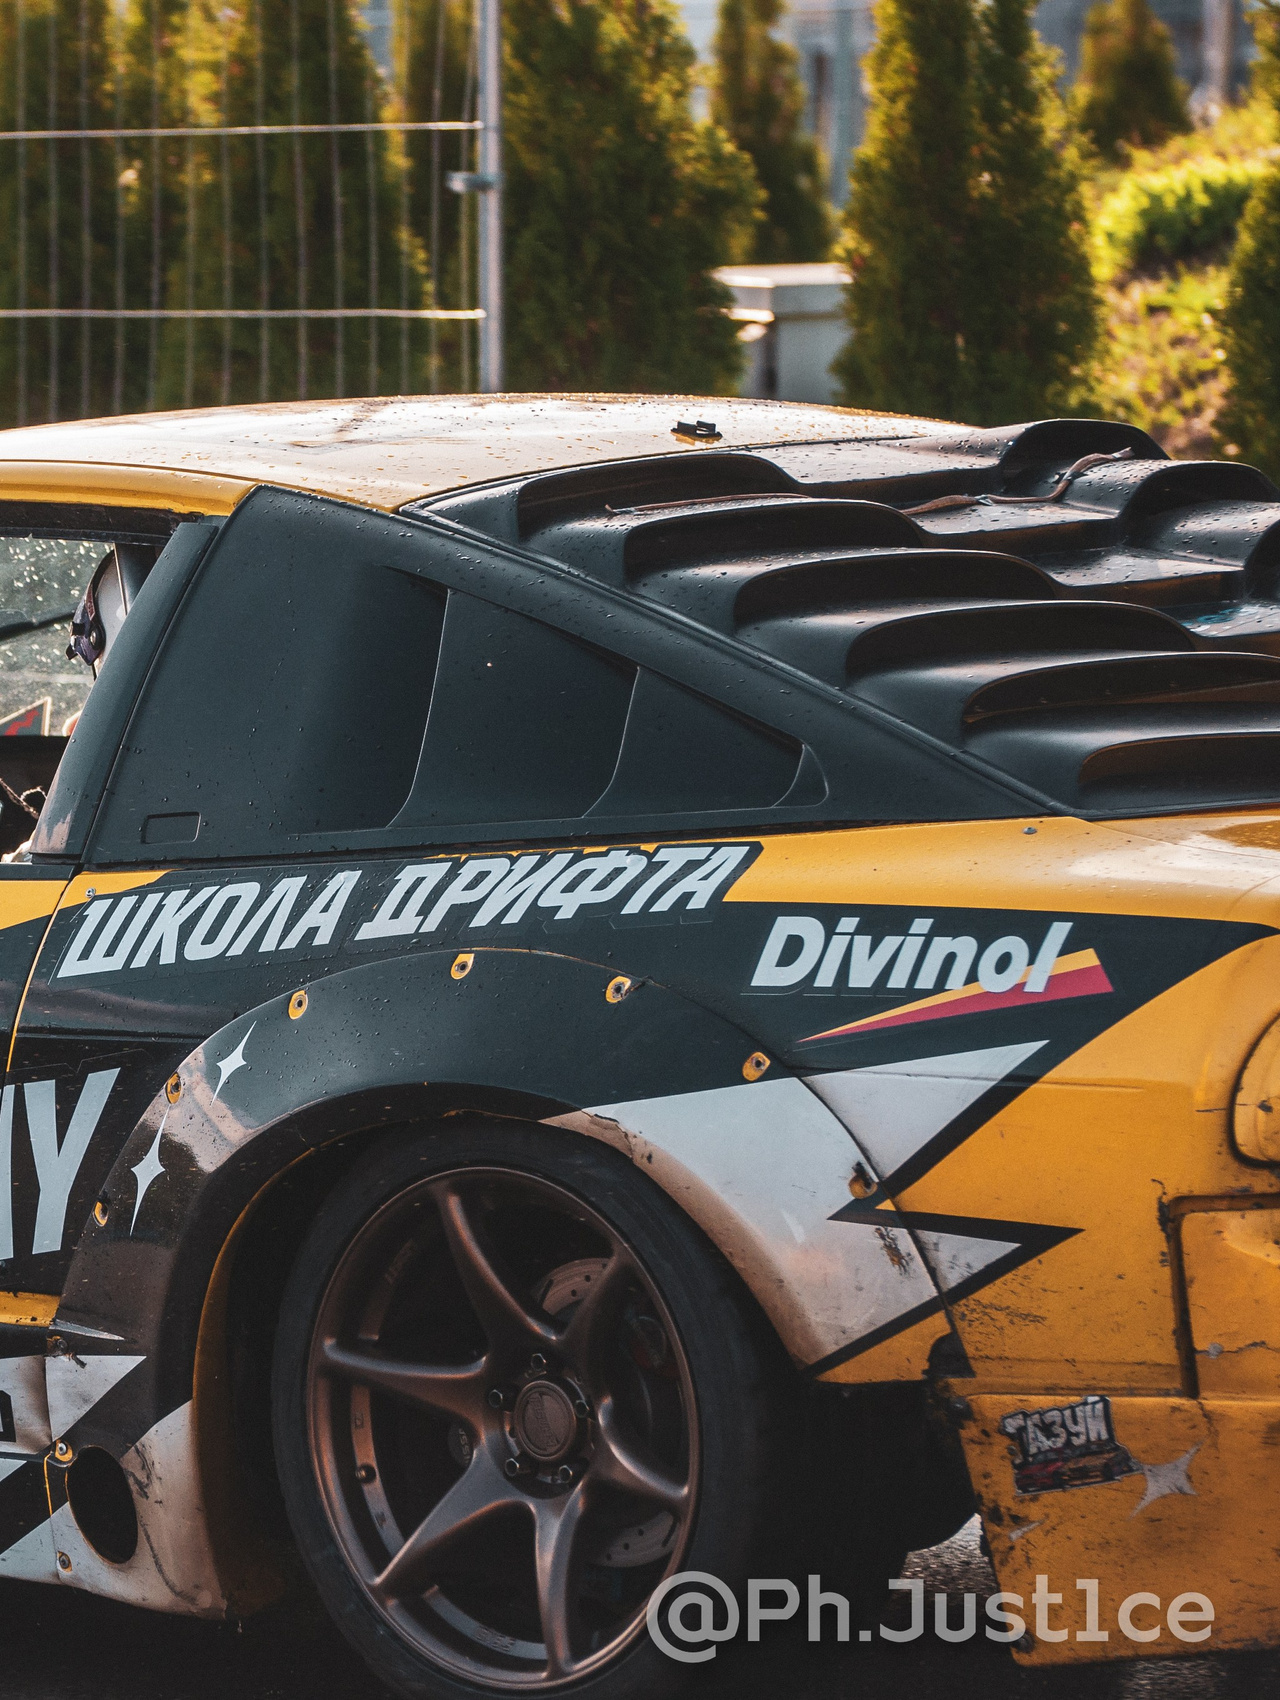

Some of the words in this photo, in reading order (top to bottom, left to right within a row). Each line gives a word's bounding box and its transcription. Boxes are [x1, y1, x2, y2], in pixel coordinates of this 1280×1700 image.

[56, 869, 362, 978] ШКОЛА
[357, 846, 751, 941] ДРИФТА
[751, 916, 1073, 993] Divinol
